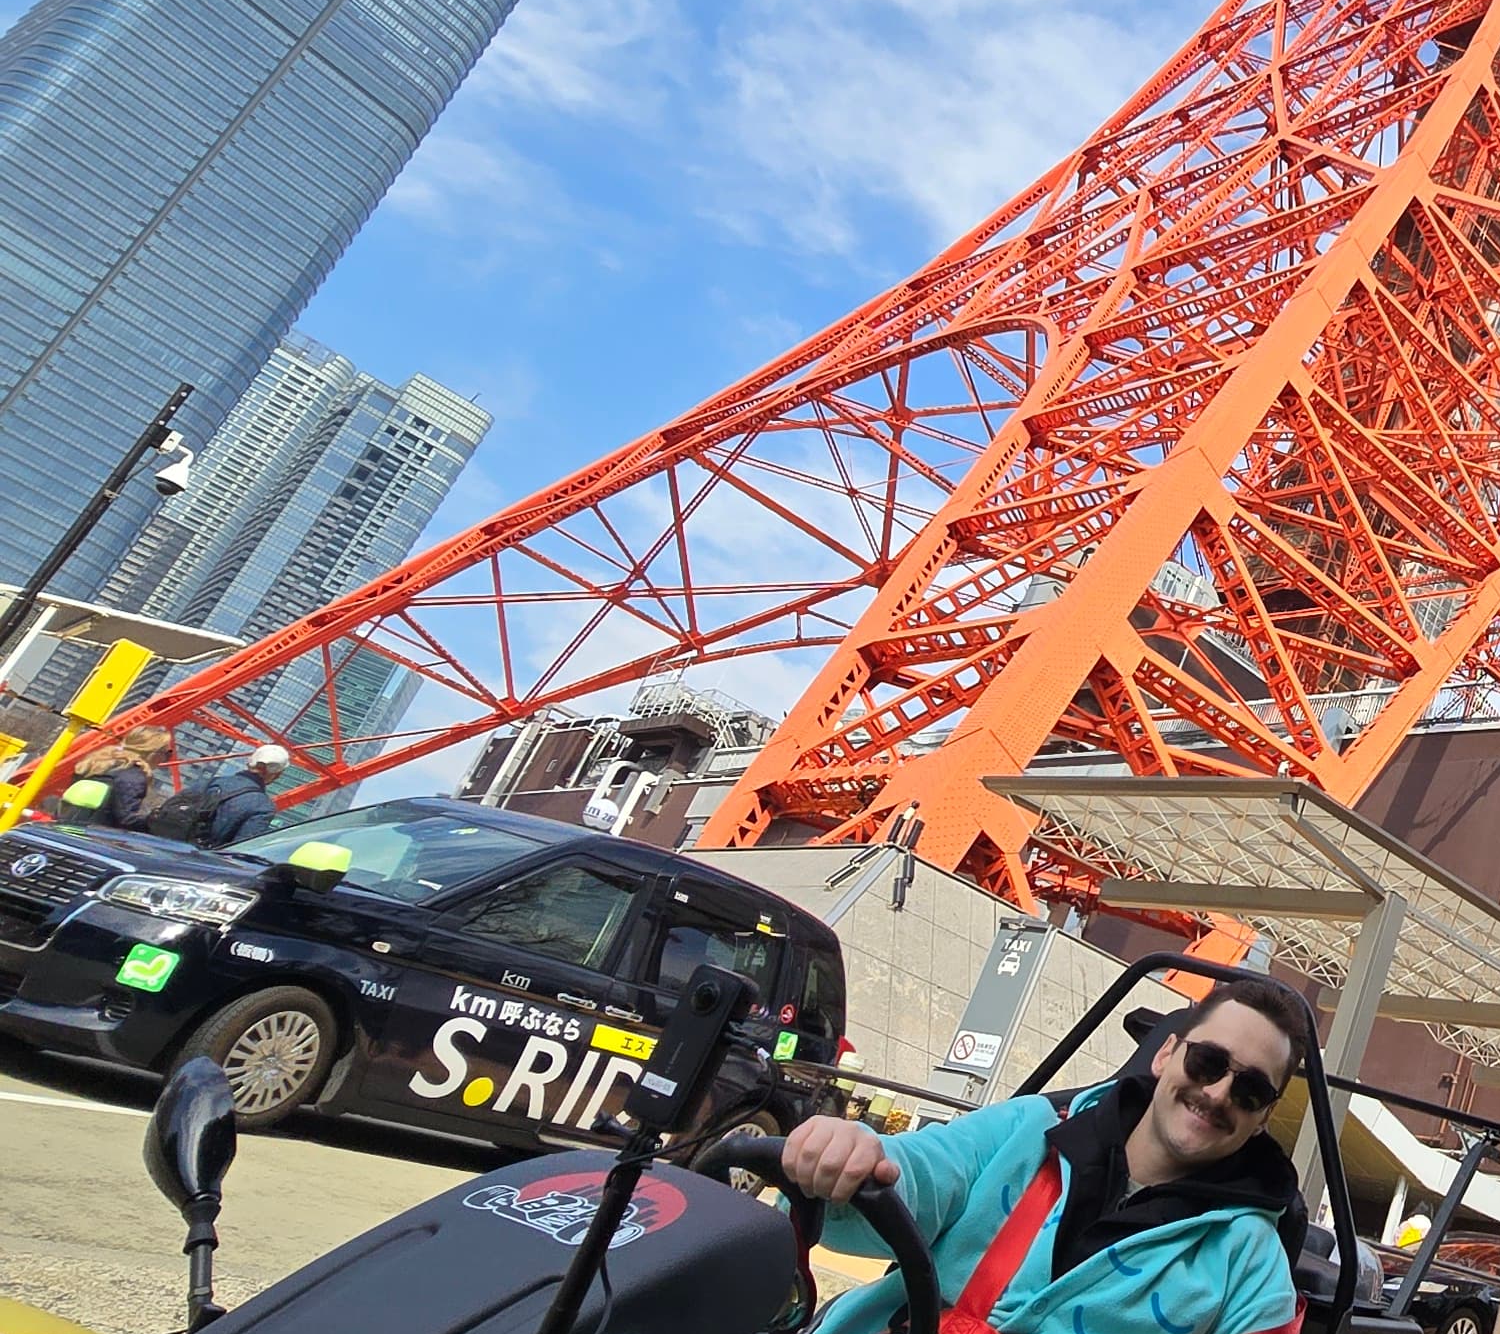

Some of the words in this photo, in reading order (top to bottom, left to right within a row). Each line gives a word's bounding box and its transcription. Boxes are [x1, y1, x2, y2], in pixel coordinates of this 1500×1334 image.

[1004, 938, 1032, 953] TAXI
[501, 969, 531, 990] km
[360, 979, 397, 1002] TAXI
